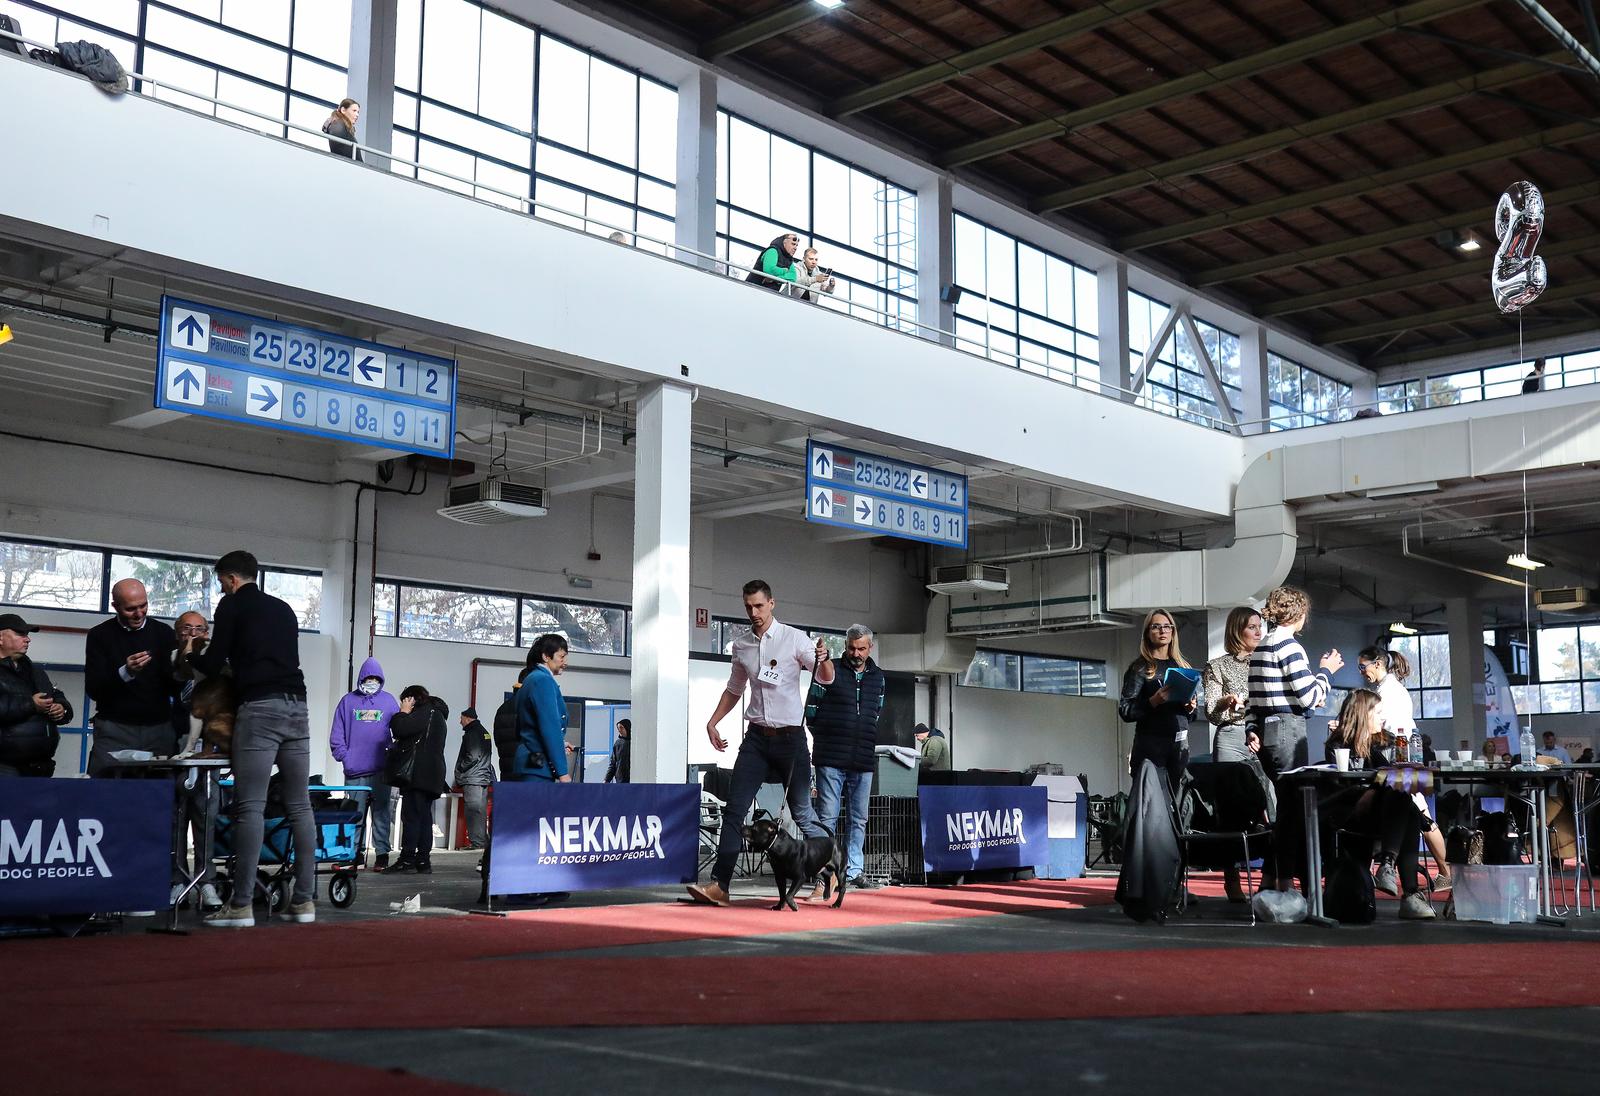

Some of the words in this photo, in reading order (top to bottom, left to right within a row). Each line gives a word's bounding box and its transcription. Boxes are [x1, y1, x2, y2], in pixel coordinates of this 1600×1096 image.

[253, 331, 283, 362] 25
[288, 339, 317, 369] 23
[322, 347, 350, 376] 22
[396, 362, 405, 388] 1
[425, 368, 438, 395] 2
[207, 390, 229, 406] Exit
[292, 391, 306, 419] 6
[326, 398, 341, 425] 8
[354, 403, 378, 433] 8a
[393, 410, 406, 437] 9
[420, 416, 439, 443] 11
[856, 461, 872, 484] 25
[875, 464, 891, 488] 23
[894, 468, 909, 492] 22
[933, 479, 939, 498] 1
[950, 482, 957, 502] 2
[878, 503, 886, 524] 6
[897, 507, 905, 527] 8
[912, 510, 926, 532] 8a
[933, 514, 940, 534] 9
[948, 518, 960, 538] 11
[763, 670, 779, 681] 472
[538, 814, 665, 859] NEKMAR
[946, 807, 1026, 844] NEKMAR
[962, 842, 977, 850] DOGS
[999, 837, 1019, 846] PEOPLE
[0, 818, 113, 878] MAR
[537, 855, 558, 866] FOR
[560, 854, 587, 865] DOGS
[589, 854, 600, 863] BY
[602, 853, 622, 863] DOG
[622, 850, 655, 860] PEOPLE
[0, 868, 32, 879] DOG
[37, 866, 95, 878] PEOPLE
